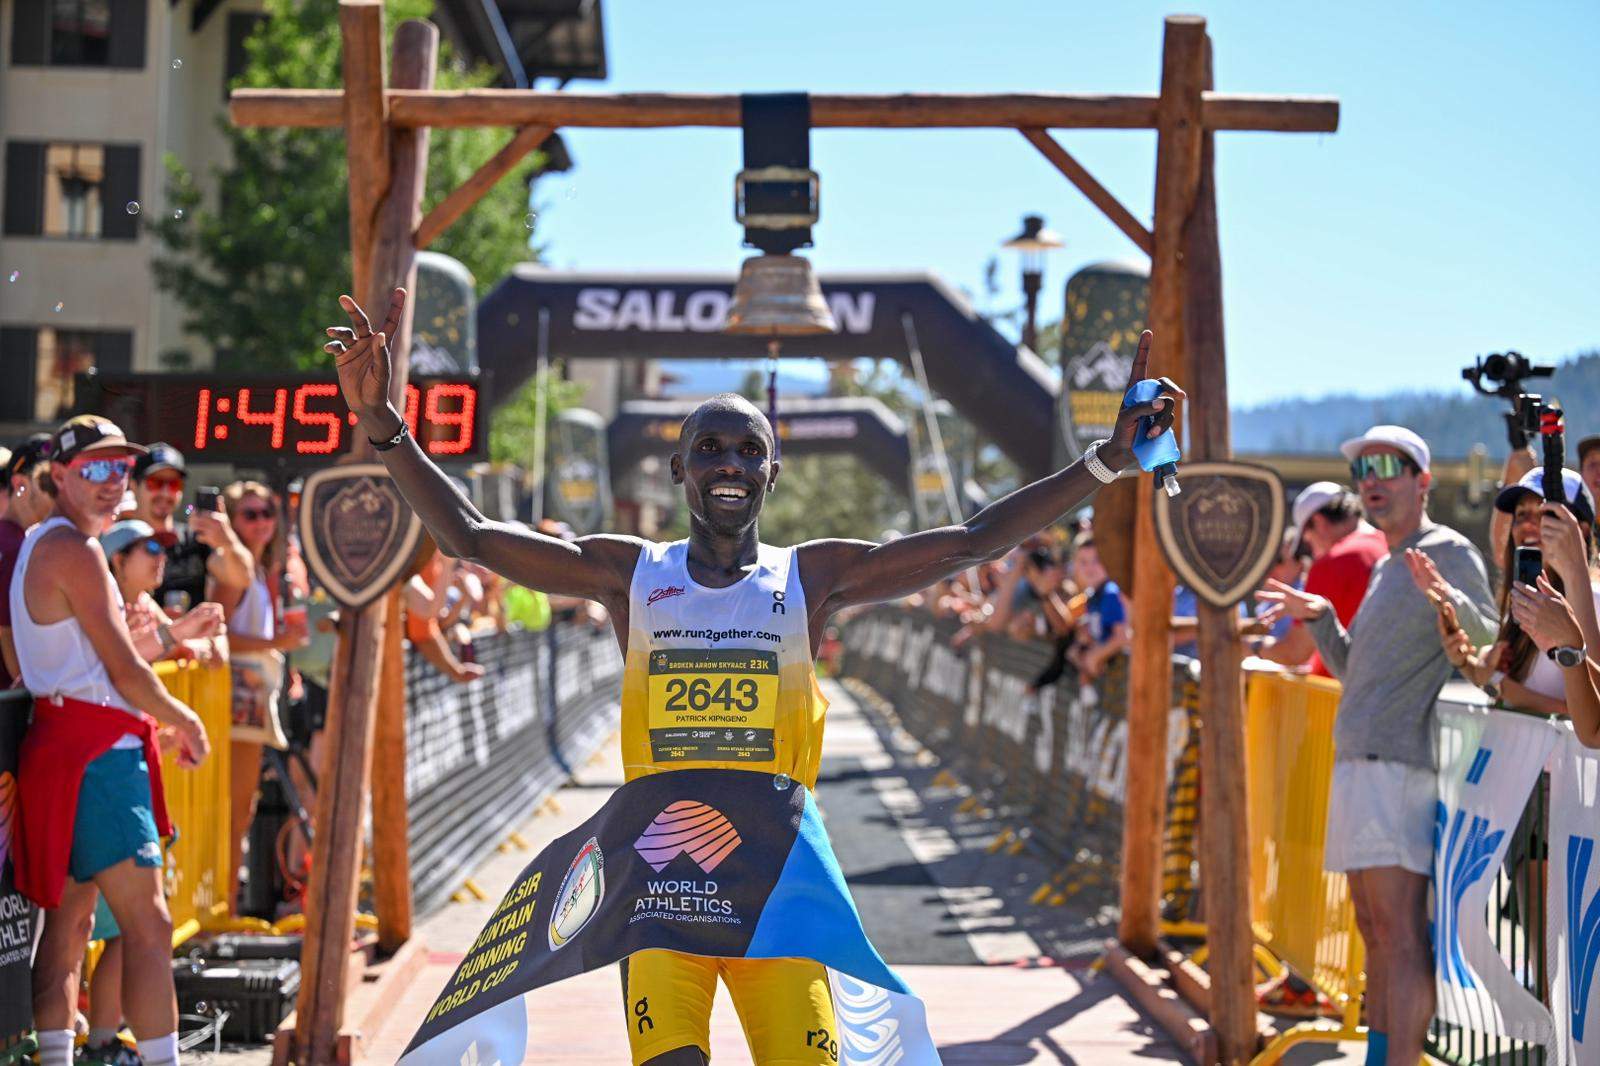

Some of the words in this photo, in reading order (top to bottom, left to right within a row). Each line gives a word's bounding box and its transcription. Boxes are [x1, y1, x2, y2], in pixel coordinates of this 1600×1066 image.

[573, 288, 875, 333] SALON
[653, 628, 782, 643] www.run2gether.com
[750, 659, 769, 670] 23K
[665, 678, 759, 712] 2643
[675, 715, 707, 723] PATRICK
[709, 715, 748, 723] KIPNGENO
[647, 880, 718, 895] WORLD
[628, 911, 674, 925] ASSOCIATED
[675, 914, 742, 925] ORGANISATIONS
[634, 896, 733, 915] ATHLETICS
[469, 899, 536, 954] OUNTAIN
[454, 931, 528, 986] RUNNING
[426, 979, 481, 1024] WORLD
[481, 960, 519, 993] CUP
[806, 1028, 838, 1063] r2g
